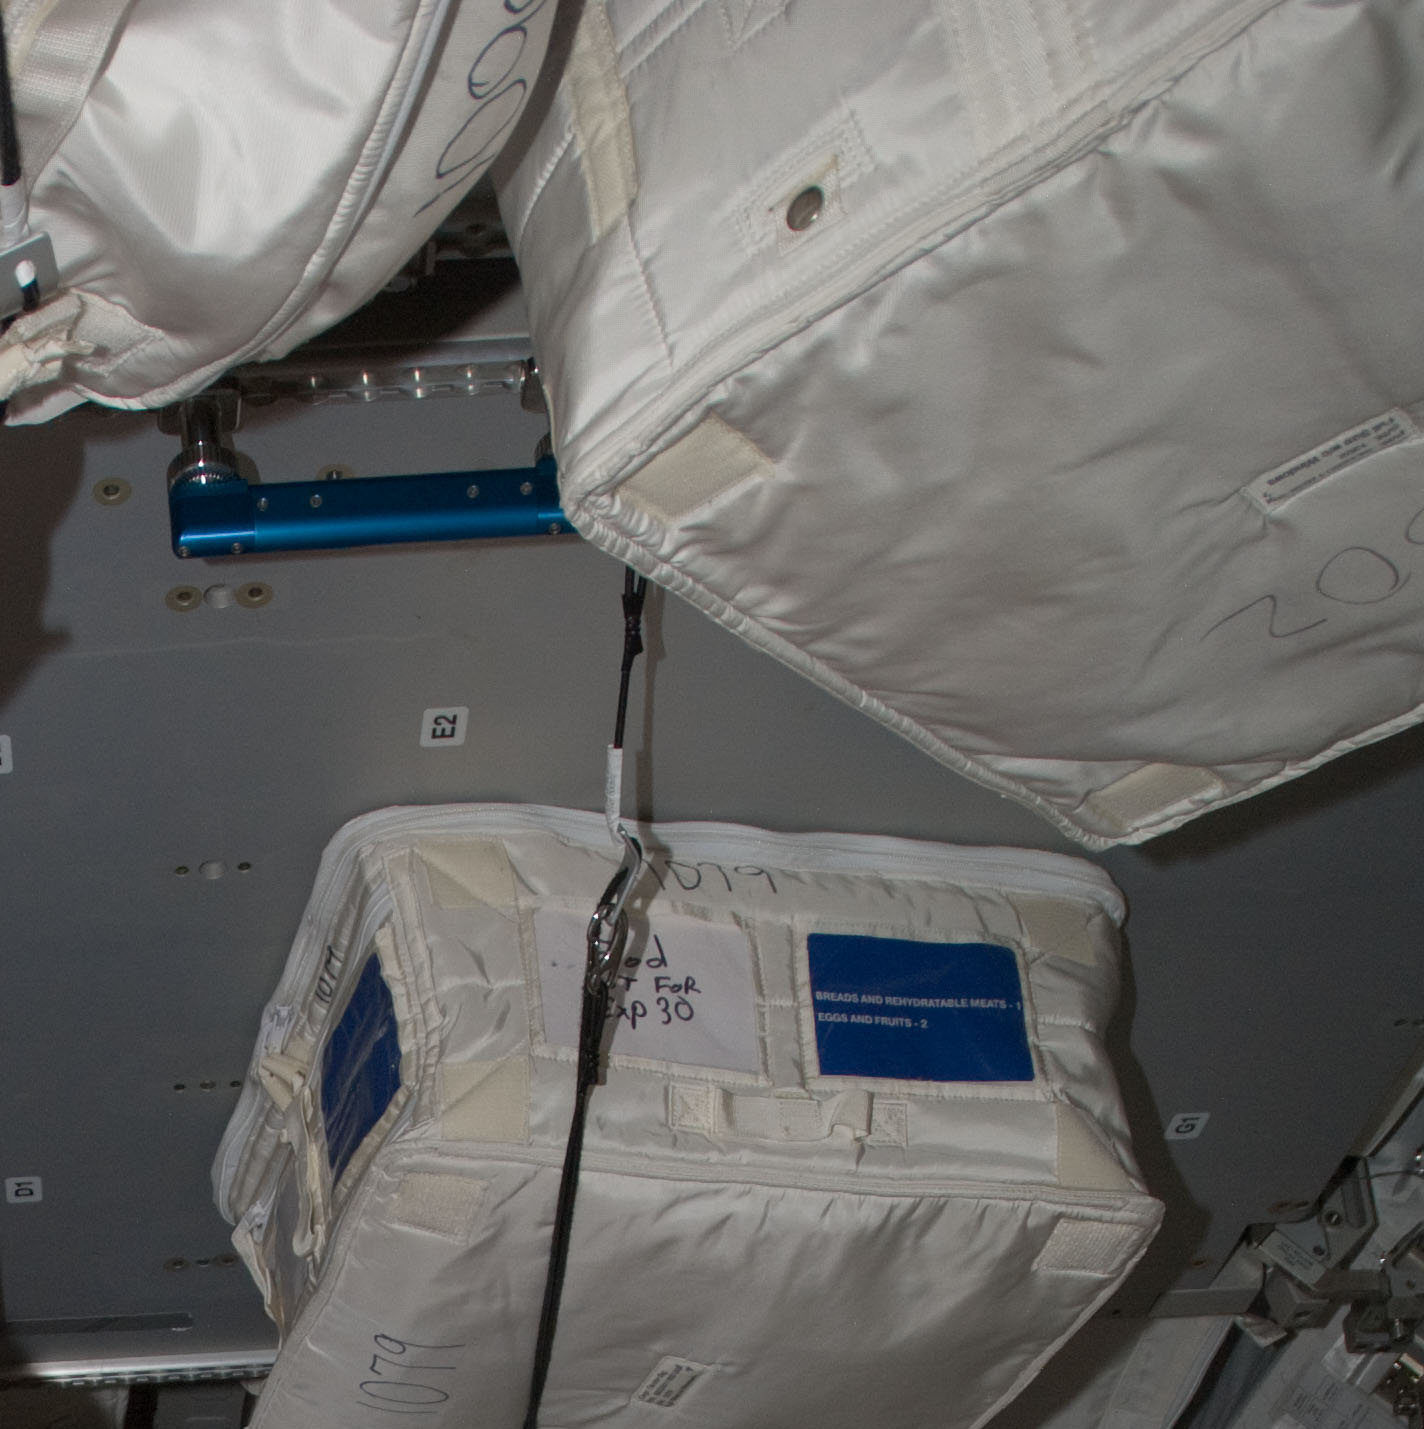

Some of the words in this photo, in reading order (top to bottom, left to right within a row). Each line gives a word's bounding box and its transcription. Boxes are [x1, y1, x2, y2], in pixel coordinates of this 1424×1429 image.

[414, 0, 548, 216] 100
[431, 713, 458, 741] E2
[657, 994, 694, 1025] 30
[815, 991, 858, 1003] BREADS
[860, 994, 883, 1005] AND
[885, 996, 969, 1008] REHYDRATABLE
[970, 998, 1006, 1009] MEATS
[817, 1012, 848, 1023] EGGS
[850, 1014, 873, 1025] AND
[875, 1016, 912, 1028] FRUITS
[1176, 1115, 1201, 1136] G1
[14, 1180, 34, 1199] D1
[357, 1330, 466, 1415] 1079
